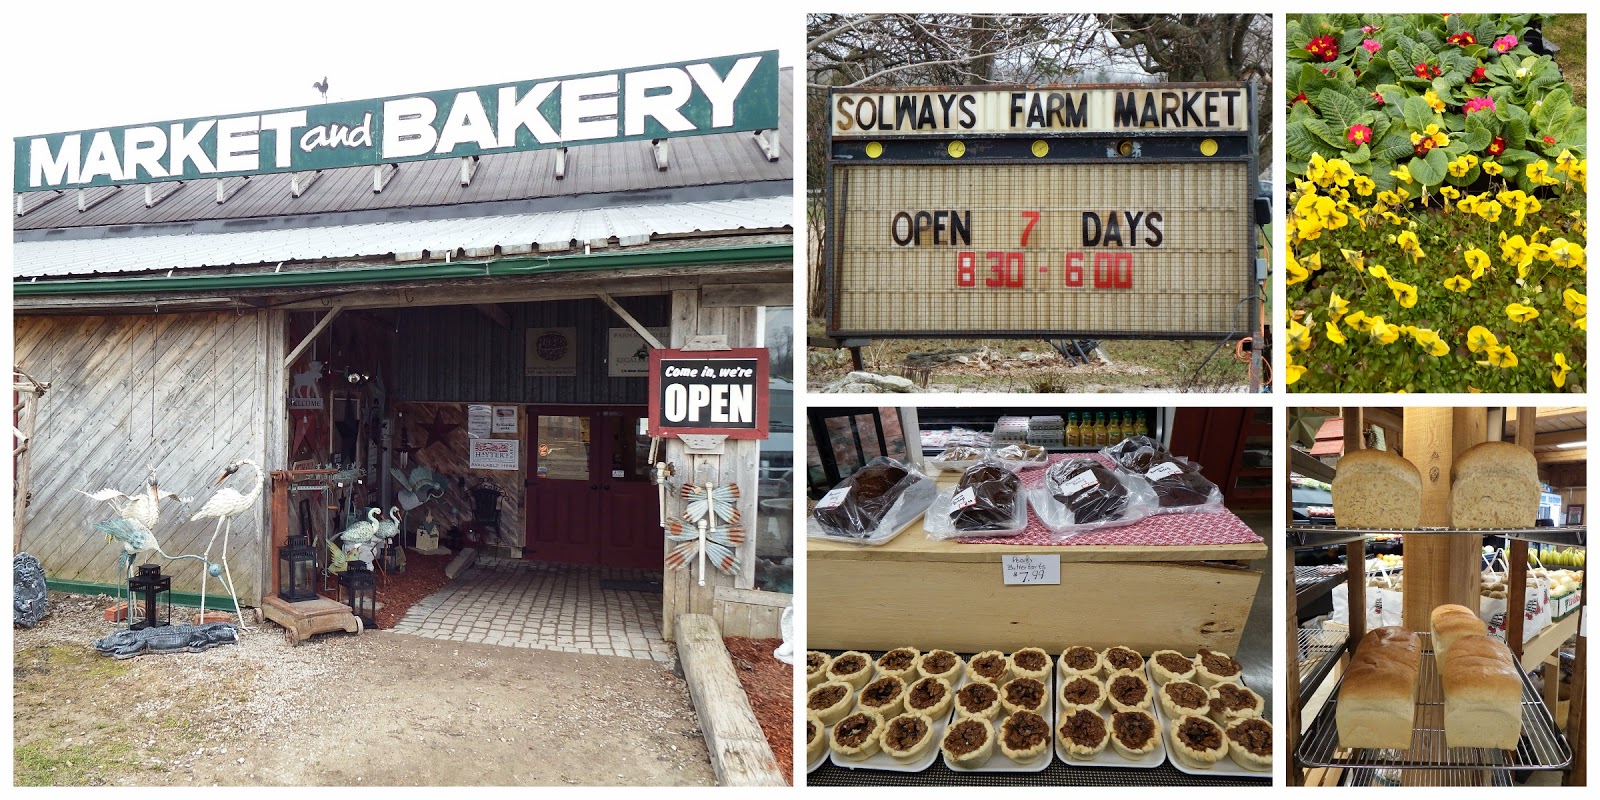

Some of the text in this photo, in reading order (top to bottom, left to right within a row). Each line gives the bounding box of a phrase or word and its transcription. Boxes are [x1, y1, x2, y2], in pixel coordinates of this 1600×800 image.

[31, 56, 763, 188] MARKET and BAKERY
[836, 90, 1241, 131] SOLWAYS FARM MARKET
[891, 210, 1164, 247] OPEN 7 DAYS
[665, 365, 753, 379] Come in, we're
[664, 383, 753, 423] OPEN
